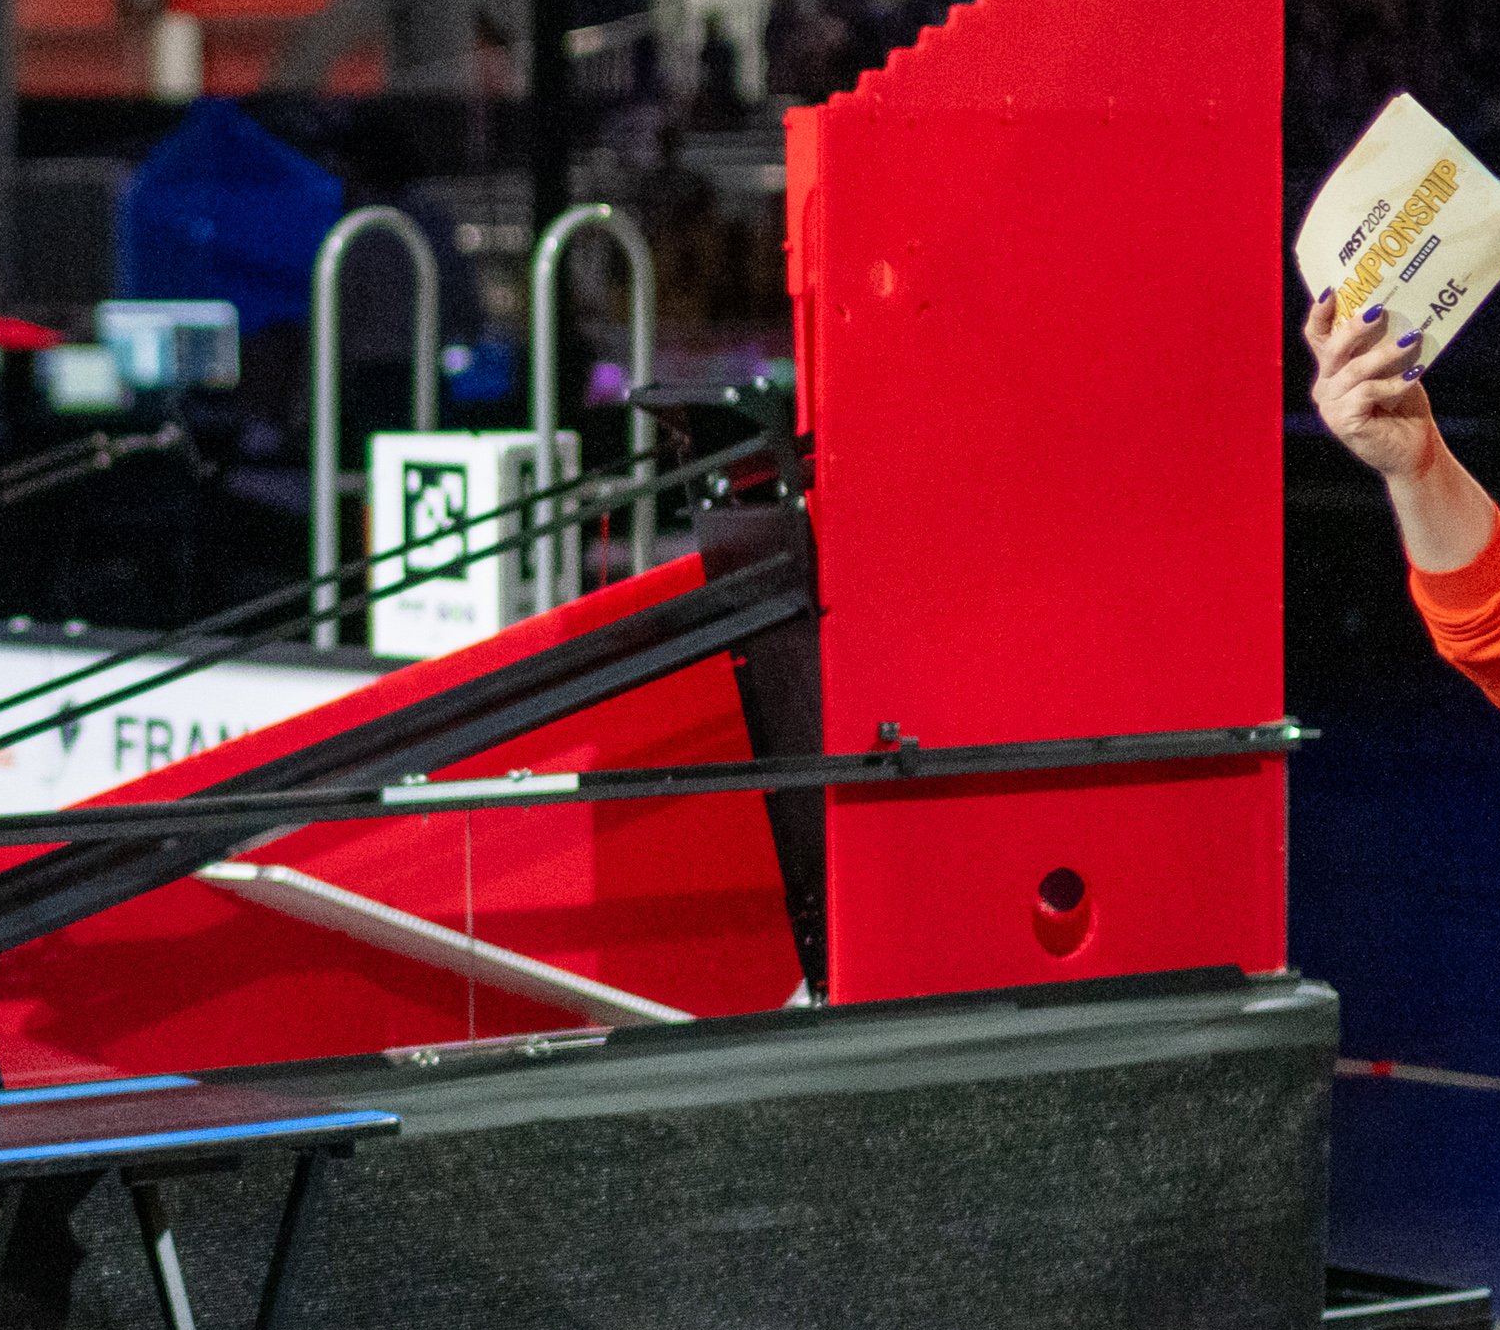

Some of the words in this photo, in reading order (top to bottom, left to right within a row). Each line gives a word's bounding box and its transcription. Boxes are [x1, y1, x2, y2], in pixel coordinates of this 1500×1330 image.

[1338, 225, 1367, 267] FIRST
[1362, 198, 1391, 233] 2026
[1428, 277, 1469, 321] AGE
